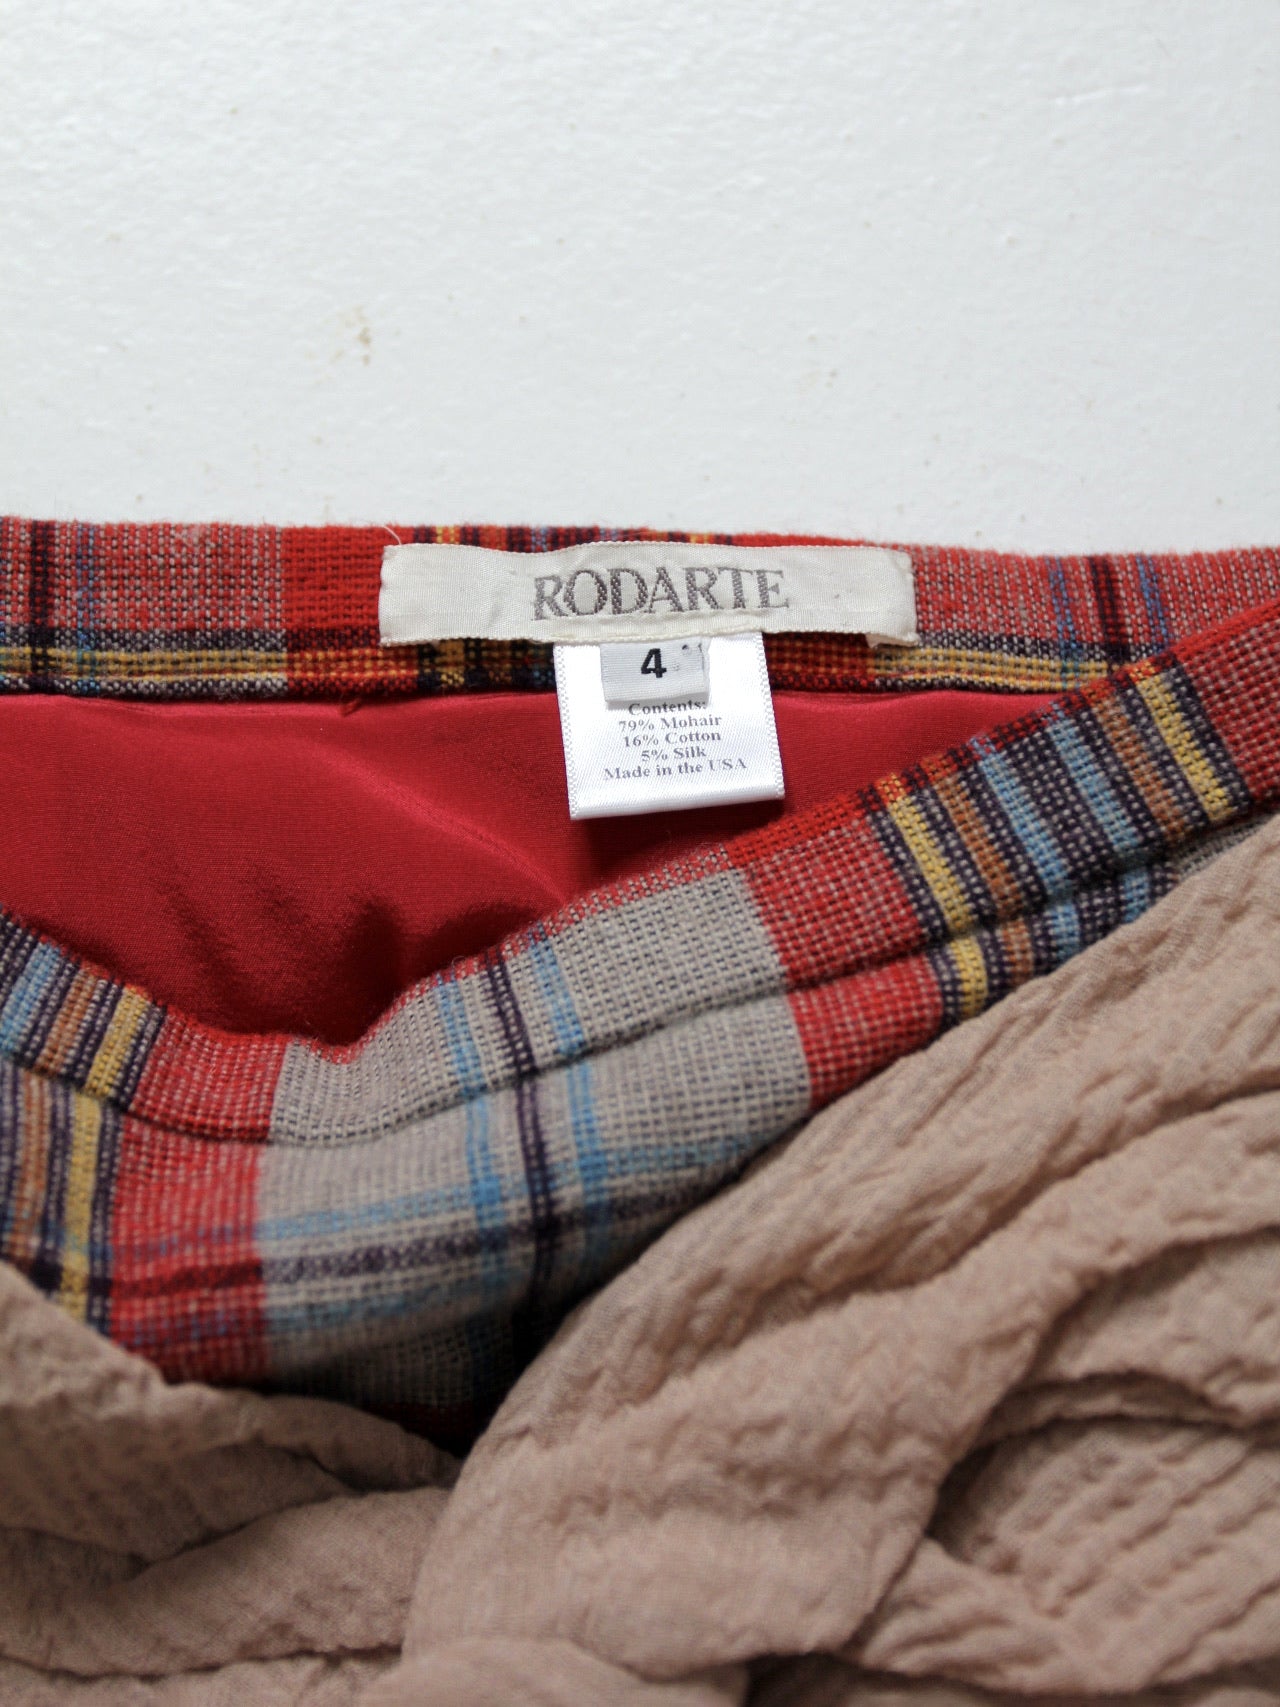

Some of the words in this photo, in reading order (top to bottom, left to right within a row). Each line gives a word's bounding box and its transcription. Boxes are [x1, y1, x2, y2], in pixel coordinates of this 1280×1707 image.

[531, 566, 789, 621] RODARTE
[641, 648, 667, 679] 4
[628, 700, 707, 716] Contents:
[618, 720, 655, 733] 79%
[660, 714, 723, 730] Mohair
[623, 733, 659, 748] 16%
[665, 730, 721, 745] Cotton
[641, 749, 668, 762] 5%
[673, 746, 707, 760] Silk
[603, 766, 649, 781] Made
[656, 763, 673, 777] in
[678, 761, 703, 775] the
[709, 758, 747, 772] USA
